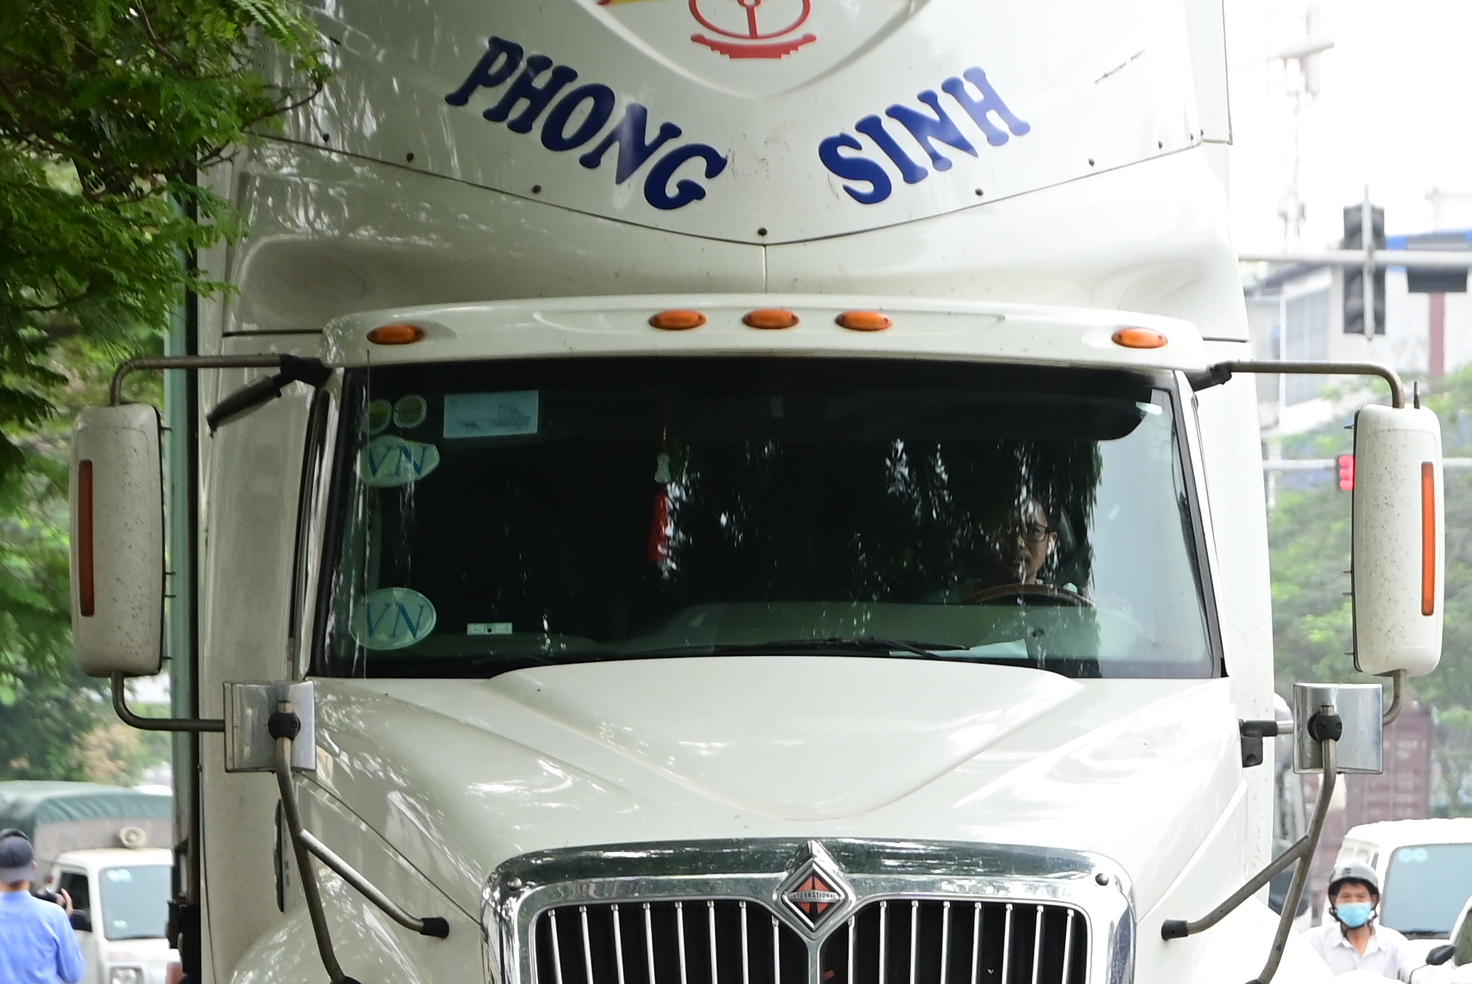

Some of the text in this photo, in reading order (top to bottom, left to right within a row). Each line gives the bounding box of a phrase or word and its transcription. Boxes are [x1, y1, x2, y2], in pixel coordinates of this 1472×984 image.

[444, 35, 1031, 211] PHONG SINH
[367, 446, 427, 478] VN
[366, 602, 426, 640] VN
